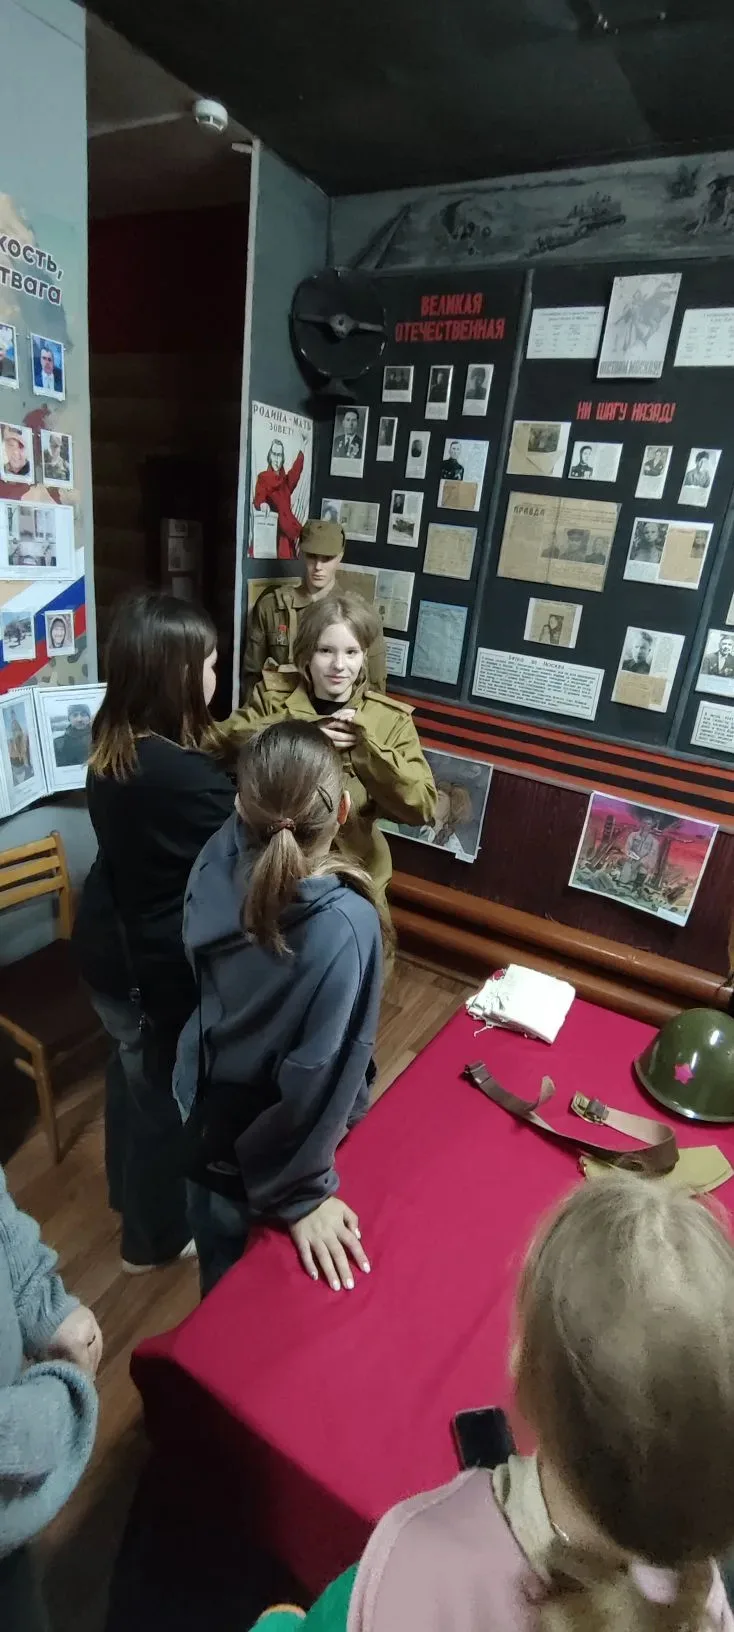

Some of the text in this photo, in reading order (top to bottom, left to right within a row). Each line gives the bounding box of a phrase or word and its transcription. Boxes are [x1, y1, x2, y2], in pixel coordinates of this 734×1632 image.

[420, 292, 483, 316] ВЕЛИКАЯ
[395, 318, 506, 342] ОТЕЧЕСТВЕННАЯ
[576, 400, 677, 424] НИ ШАГУ НАЗАД!
